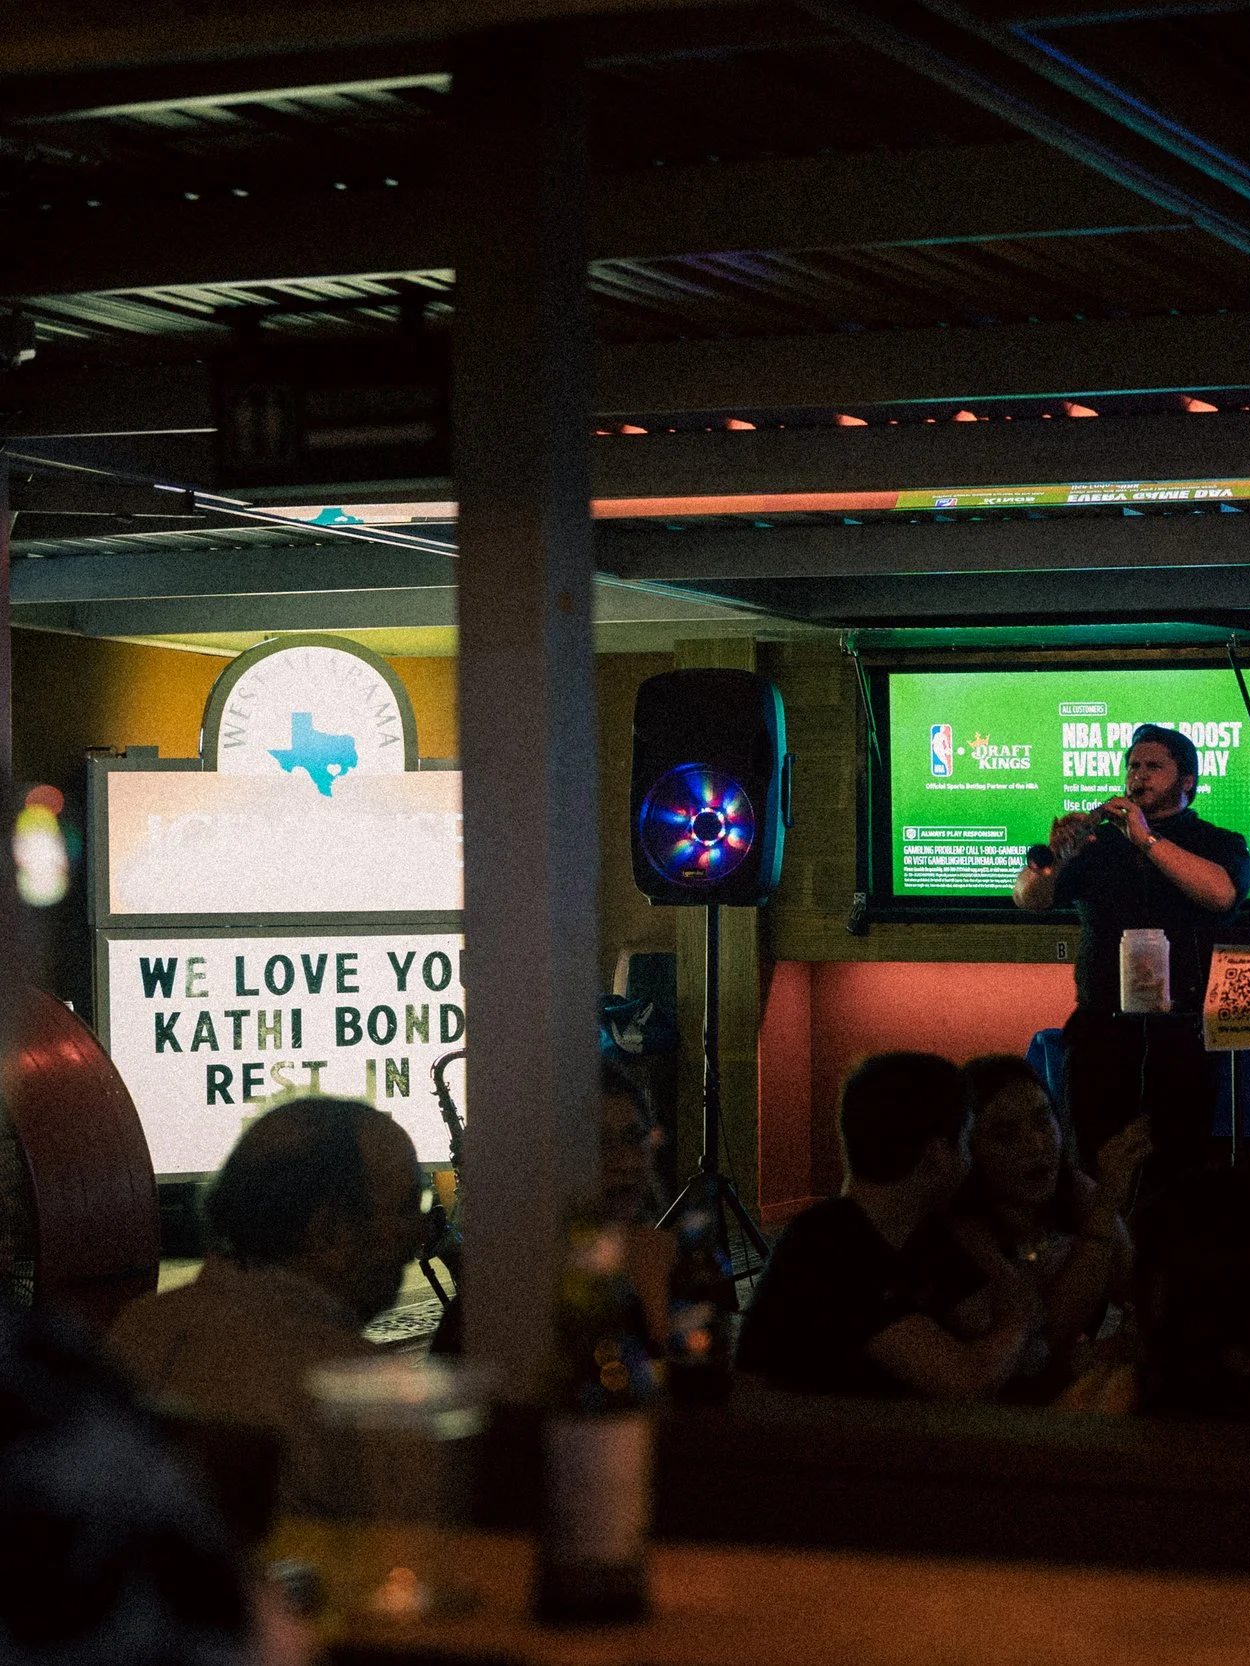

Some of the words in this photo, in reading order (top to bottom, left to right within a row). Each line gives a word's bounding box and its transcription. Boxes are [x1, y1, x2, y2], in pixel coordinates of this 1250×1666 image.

[223, 673, 264, 749] WEST
[1063, 705, 1072, 713] ALL
[1073, 705, 1104, 713] CUSTOMERS
[1062, 723, 1103, 748] NBA
[971, 745, 1032, 759] DRAFT
[979, 757, 1031, 769] KINGS
[1062, 751, 1123, 776] EVERY
[1063, 784, 1080, 792] Profit
[1080, 784, 1096, 792] Boost
[1097, 784, 1108, 792] and
[1064, 800, 1080, 811] Use
[904, 846, 935, 854] GAMBLING
[935, 846, 964, 854] PROBLEM?
[966, 846, 979, 854] CALL
[980, 846, 1027, 854] 1-800-GAMBLER
[904, 856, 912, 865] OR
[913, 856, 928, 865] VISIT
[139, 956, 209, 998] WE
[235, 953, 359, 996] LOVE
[154, 1008, 303, 1053] KATHI
[206, 1060, 328, 1105] REST
[365, 1057, 410, 1101] IN
